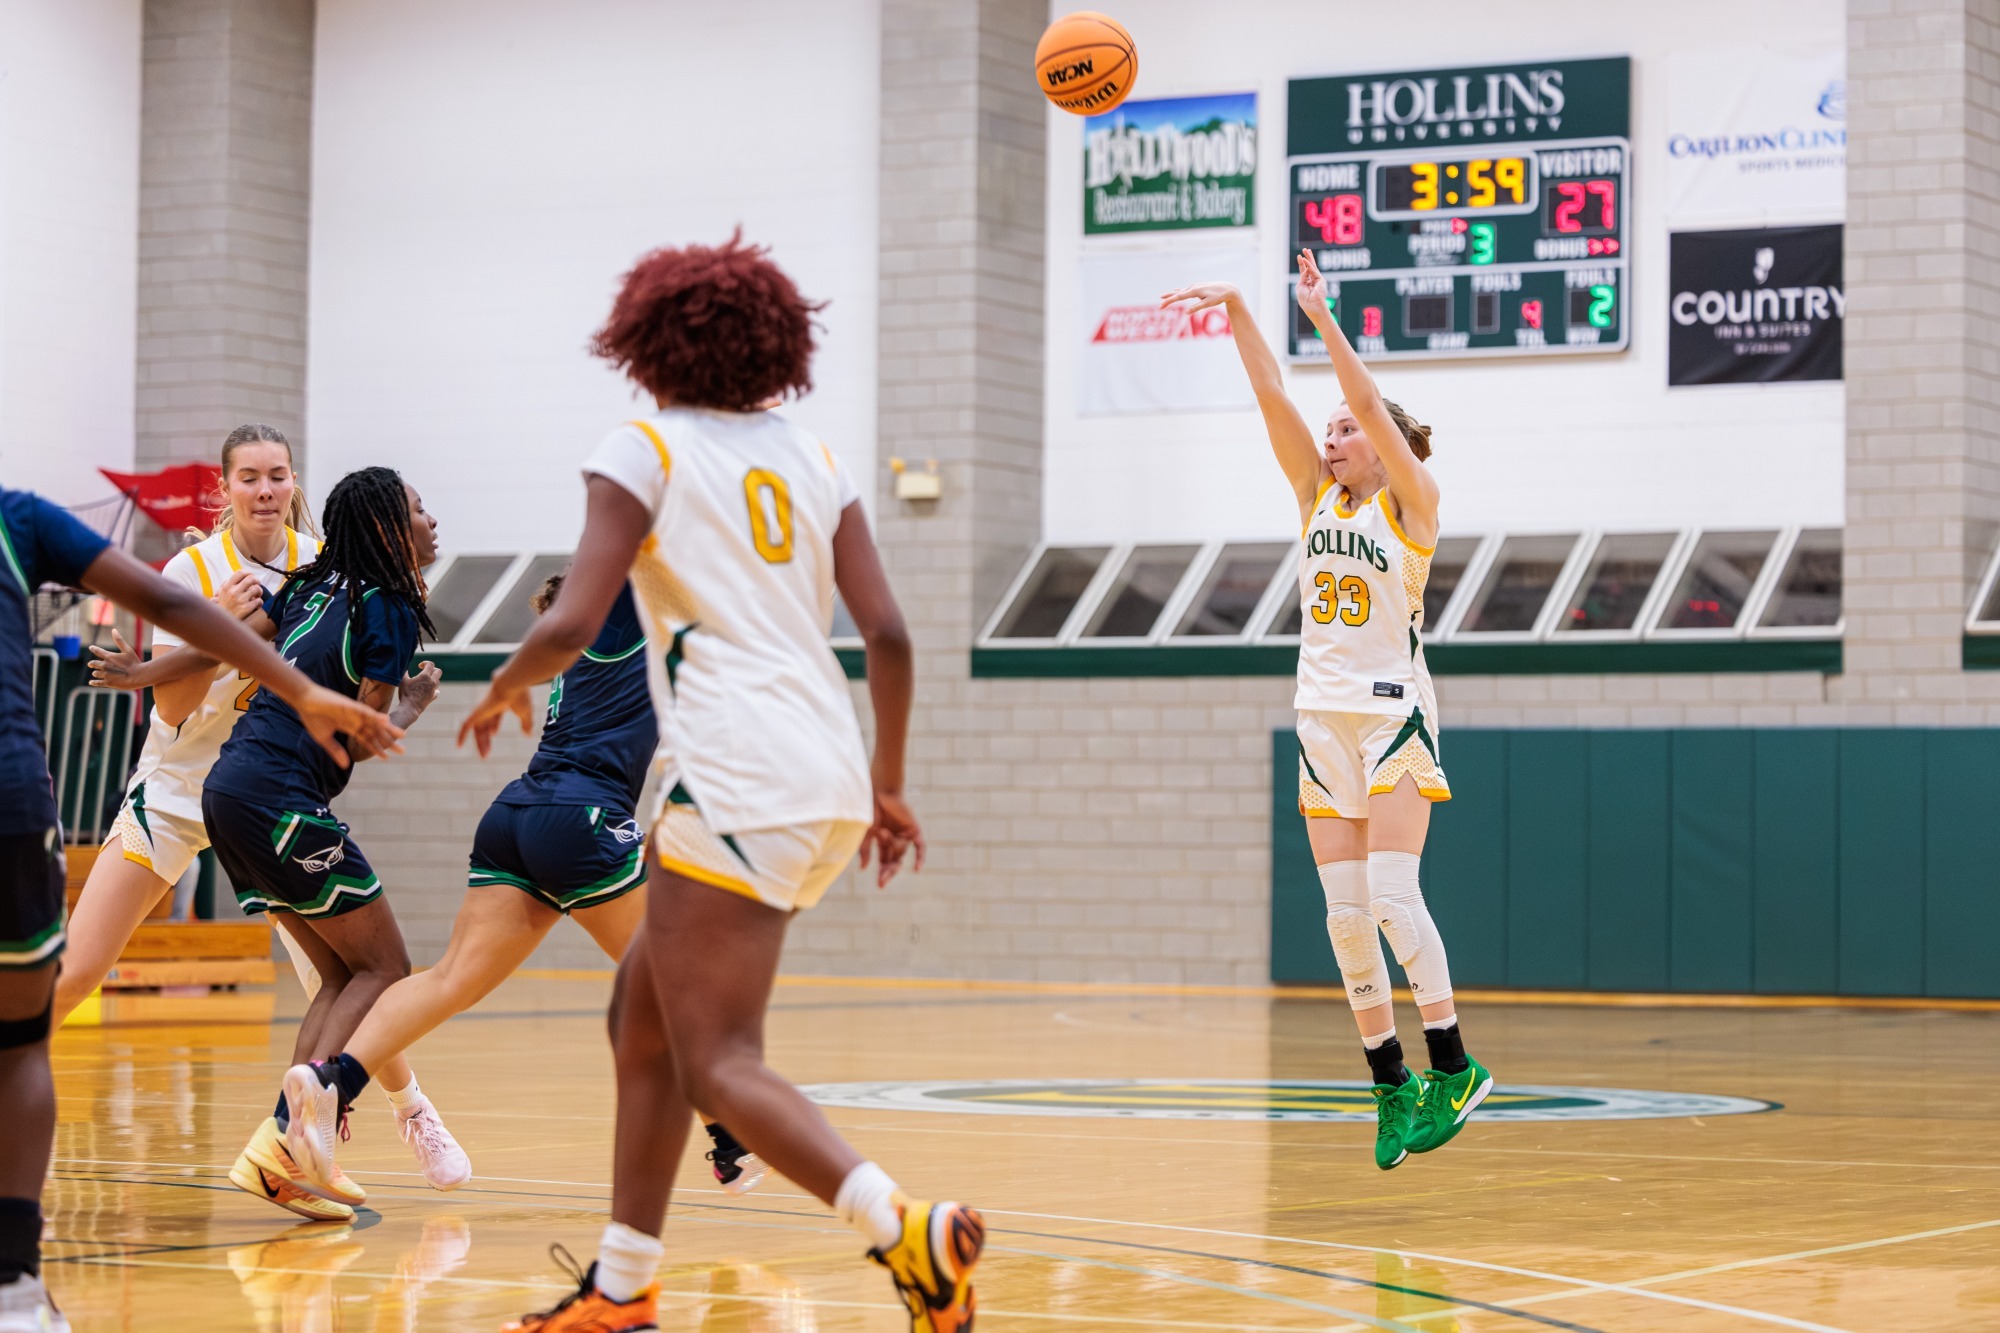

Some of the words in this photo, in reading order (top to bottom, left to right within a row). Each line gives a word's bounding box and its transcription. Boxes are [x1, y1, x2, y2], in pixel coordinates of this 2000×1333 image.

[1046, 59, 1094, 87] NCAA
[1346, 69, 1565, 128] HOLLINS
[1347, 116, 1562, 144] UNIVERSITY
[1299, 165, 1360, 191] HOME
[1410, 157, 1525, 211] 3:59
[1541, 149, 1622, 177] VISITOR
[1193, 180, 1246, 225] Bakery
[1304, 194, 1362, 244] 48
[1555, 180, 1615, 233] 27
[1318, 249, 1371, 270] BONUS
[1470, 223, 1495, 265] 3
[1534, 238, 1588, 260] BONUS
[1395, 276, 1454, 296] PLAYER
[1471, 272, 1521, 292] FOULS
[1588, 284, 1614, 328] 2
[744, 467, 794, 564] 0
[1311, 571, 1371, 627] 33
